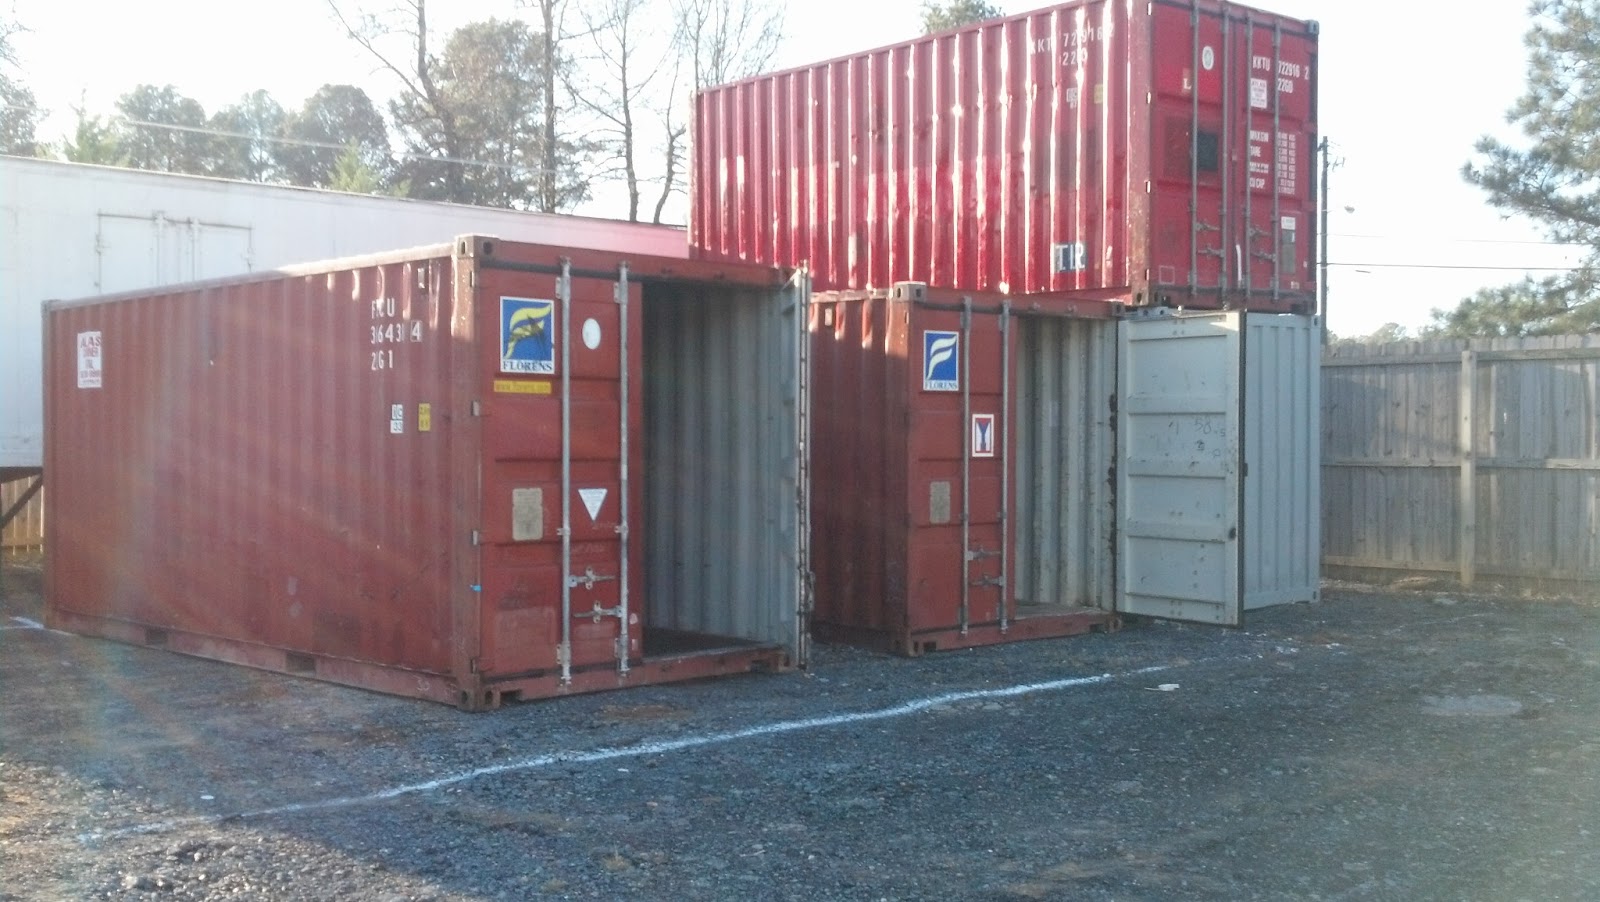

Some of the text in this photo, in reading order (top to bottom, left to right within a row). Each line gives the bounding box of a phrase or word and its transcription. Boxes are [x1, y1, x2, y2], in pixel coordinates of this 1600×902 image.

[1252, 56, 1270, 71] KKTU
[1304, 66, 1309, 80] 2
[1055, 244, 1085, 270] TIR
[411, 321, 421, 341] 4
[502, 360, 553, 371] FLORENS
